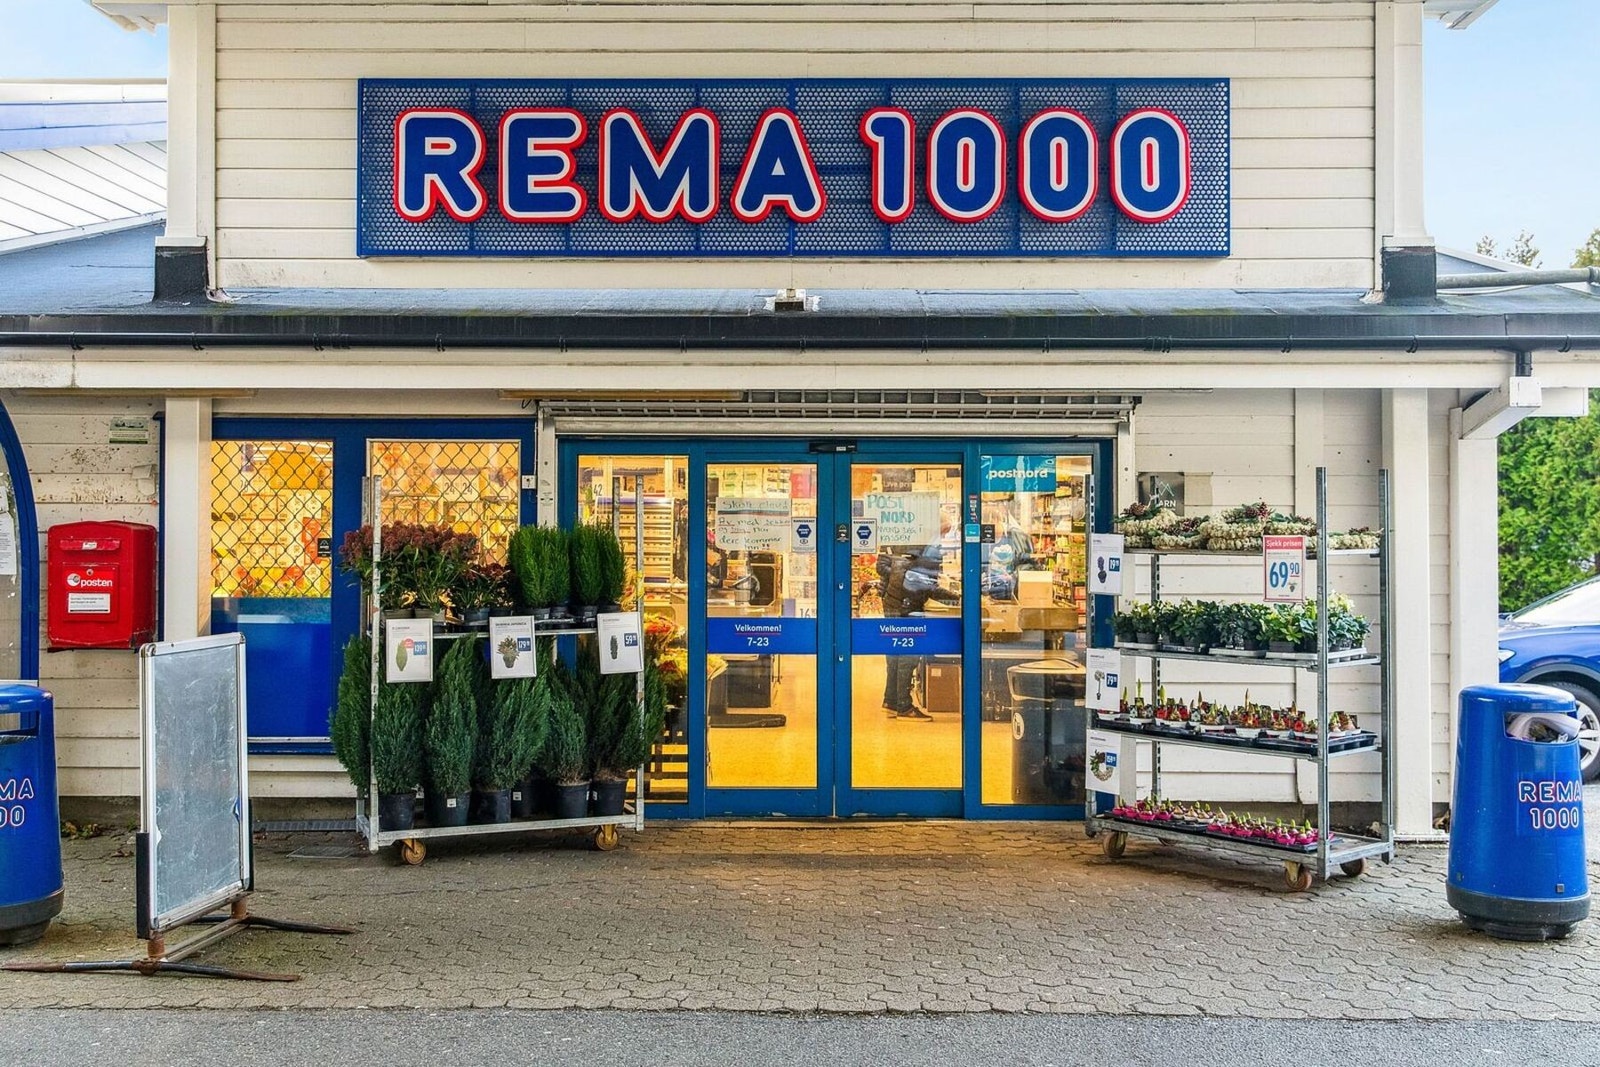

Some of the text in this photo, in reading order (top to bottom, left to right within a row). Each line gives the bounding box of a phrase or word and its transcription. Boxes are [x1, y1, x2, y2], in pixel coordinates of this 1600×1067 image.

[394, 106, 1191, 224] REMA 1000
[988, 468, 1049, 480] postnord
[867, 495, 904, 509] POST
[880, 510, 915, 523] NORD
[1266, 540, 1302, 548] Sjekk prisen
[1269, 561, 1300, 588] 69 90
[80, 578, 113, 588] posten
[735, 624, 782, 633] Velkommen!
[879, 624, 927, 633] Velkommen!
[747, 637, 770, 647] 7-23
[892, 638, 915, 647] 7-23
[0, 777, 34, 800] MA
[1519, 780, 1583, 802] REMA
[1530, 807, 1579, 829] 1000
